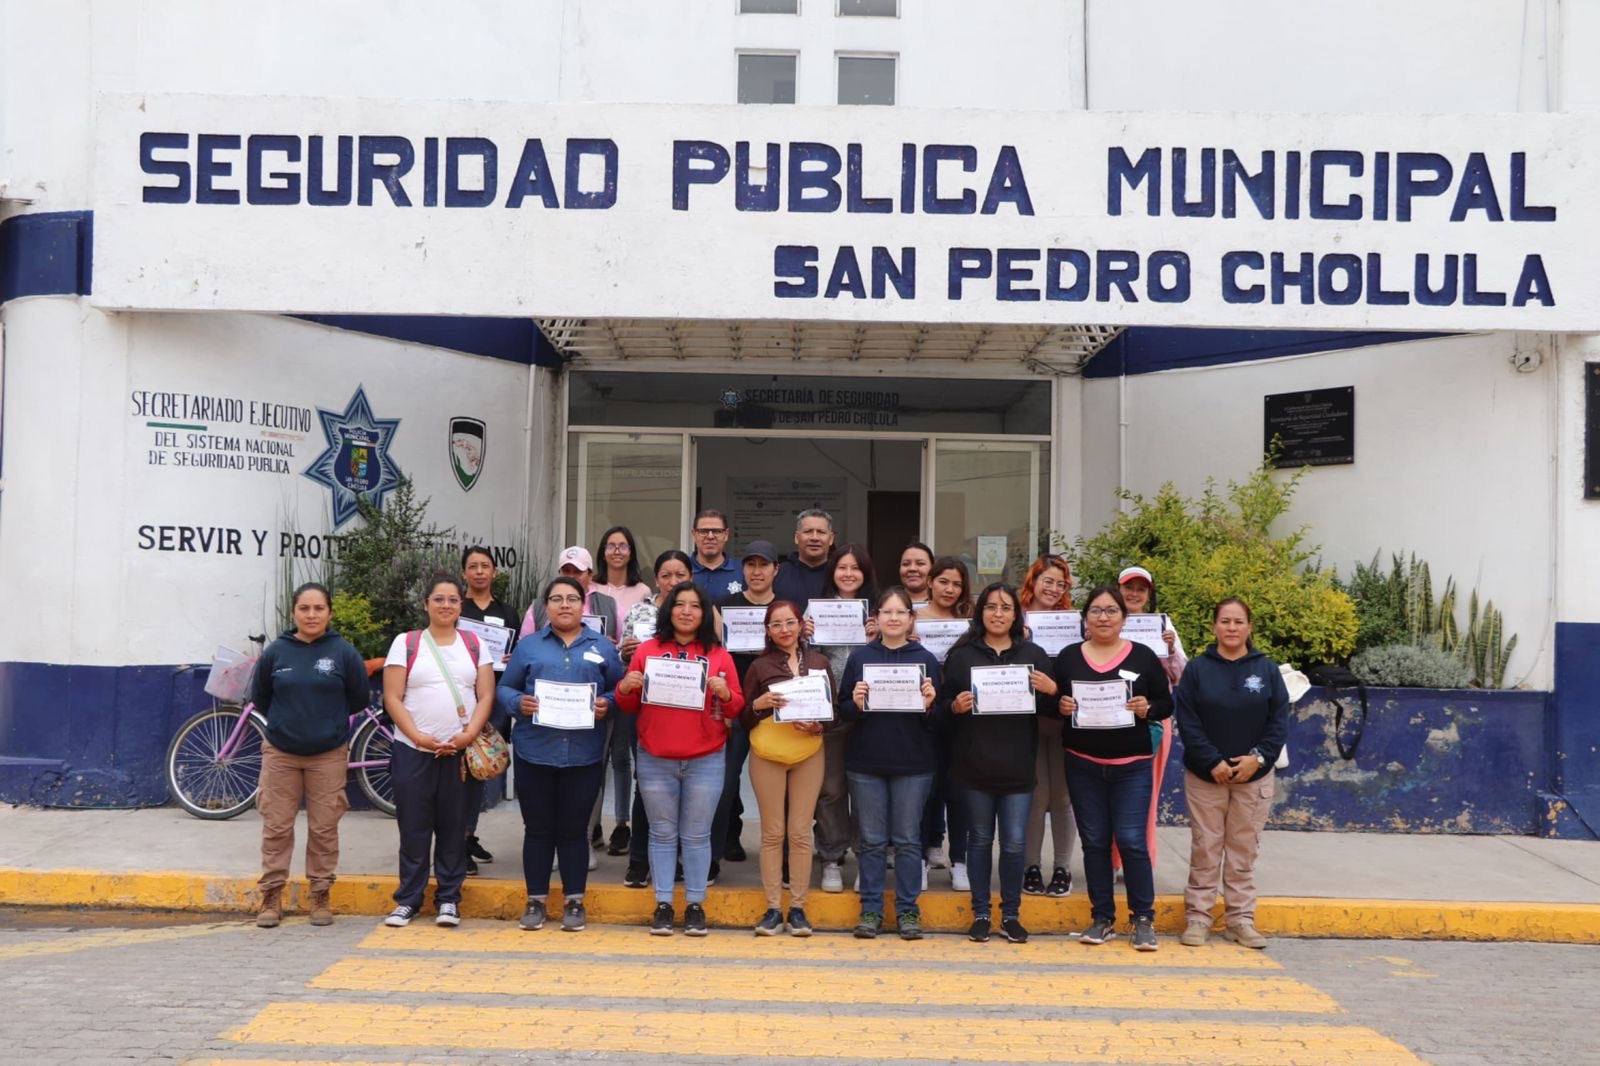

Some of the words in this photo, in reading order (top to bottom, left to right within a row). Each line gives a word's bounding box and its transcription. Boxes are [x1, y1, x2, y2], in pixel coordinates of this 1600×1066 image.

[139, 132, 619, 210] SEGURIDAD
[672, 140, 1035, 216] PUBLICA
[1107, 146, 1557, 222] MUNICIPAL
[774, 245, 916, 299] SAN
[948, 247, 1191, 303] PEDRO
[1221, 251, 1556, 307] CHOLULA
[131, 390, 244, 423] SECRETARIADO
[250, 401, 311, 432] EJECUTIVO
[744, 388, 815, 404] SECRETARÍA
[818, 390, 835, 405] DE
[836, 390, 900, 407] SEGURIDAD
[793, 411, 815, 424] SAN
[818, 411, 850, 424] PEDRO
[853, 411, 898, 426] CHOLULA
[155, 431, 180, 448] DEL
[186, 433, 241, 452] SISTEMA
[245, 438, 295, 457] NACIONAL
[148, 450, 168, 465] DE
[173, 451, 244, 470] SEGURIDAD
[248, 455, 290, 474] PUBLICA
[138, 525, 243, 555] SERVIR
[251, 529, 268, 556] Y
